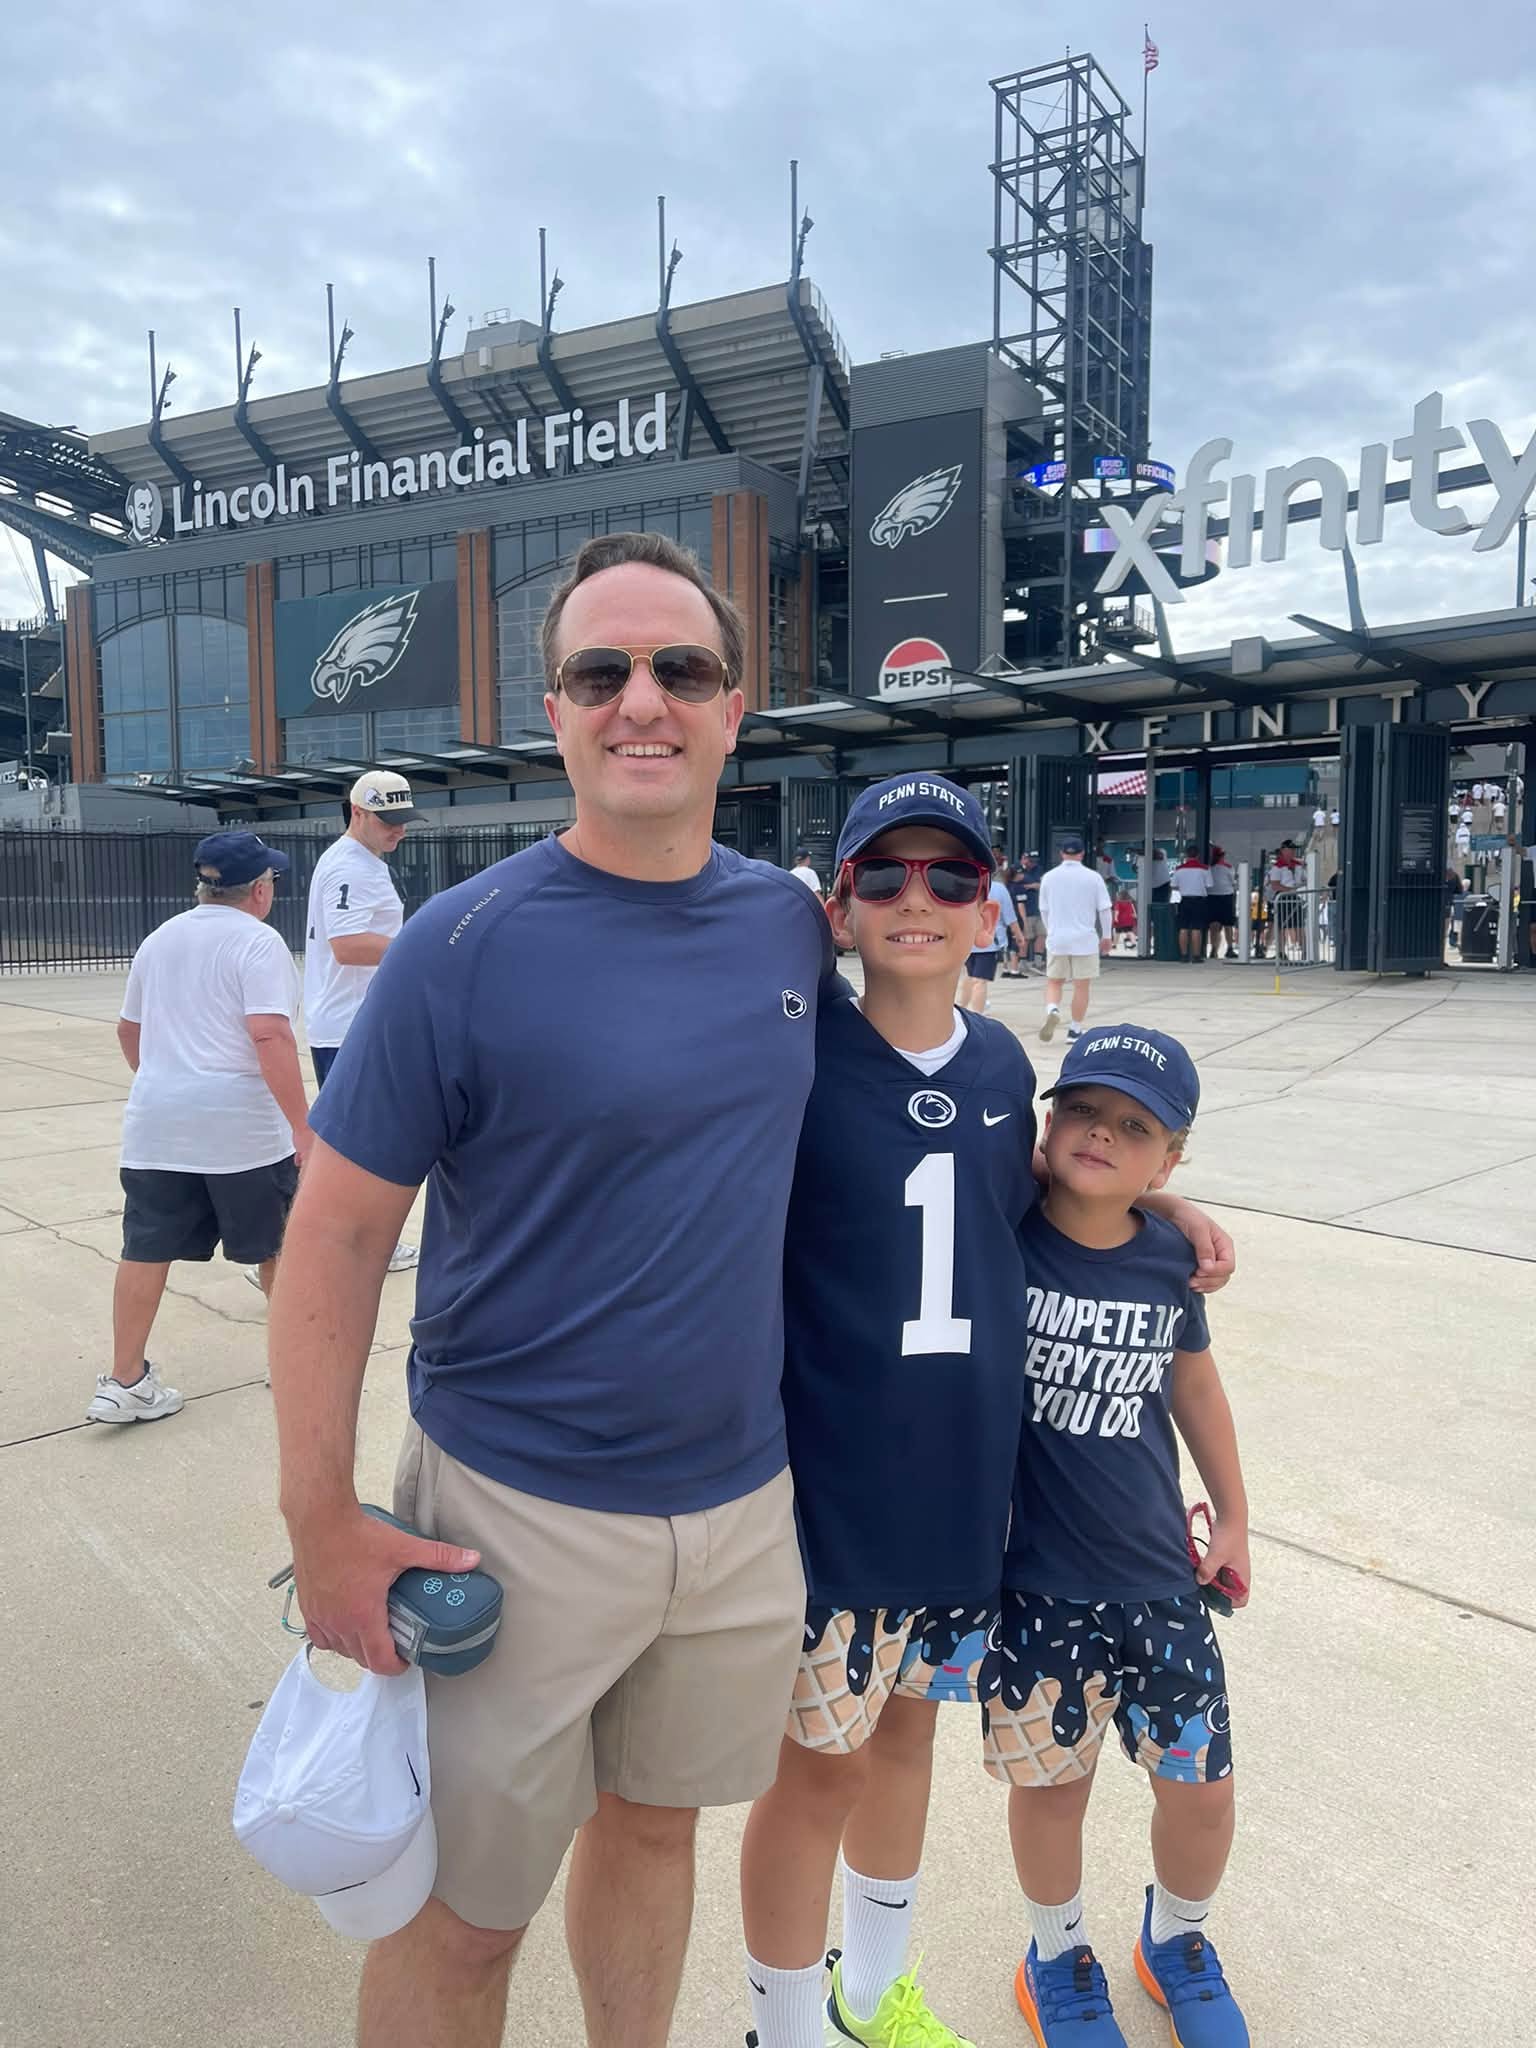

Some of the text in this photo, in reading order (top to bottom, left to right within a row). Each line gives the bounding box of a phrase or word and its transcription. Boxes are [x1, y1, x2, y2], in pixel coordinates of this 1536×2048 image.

[172, 391, 667, 532] Lincoln Financial Field
[879, 782, 965, 816] PENN STATE
[336, 883, 349, 910] 1
[448, 887, 501, 945] PETER MILLAR
[1084, 1035, 1168, 1071] PENN STATE
[902, 1153, 971, 1356] 1
[1027, 1286, 1151, 1347] OMPETE
[1024, 1335, 1174, 1394] ERYTHING
[1032, 1383, 1144, 1438] YOU DO
